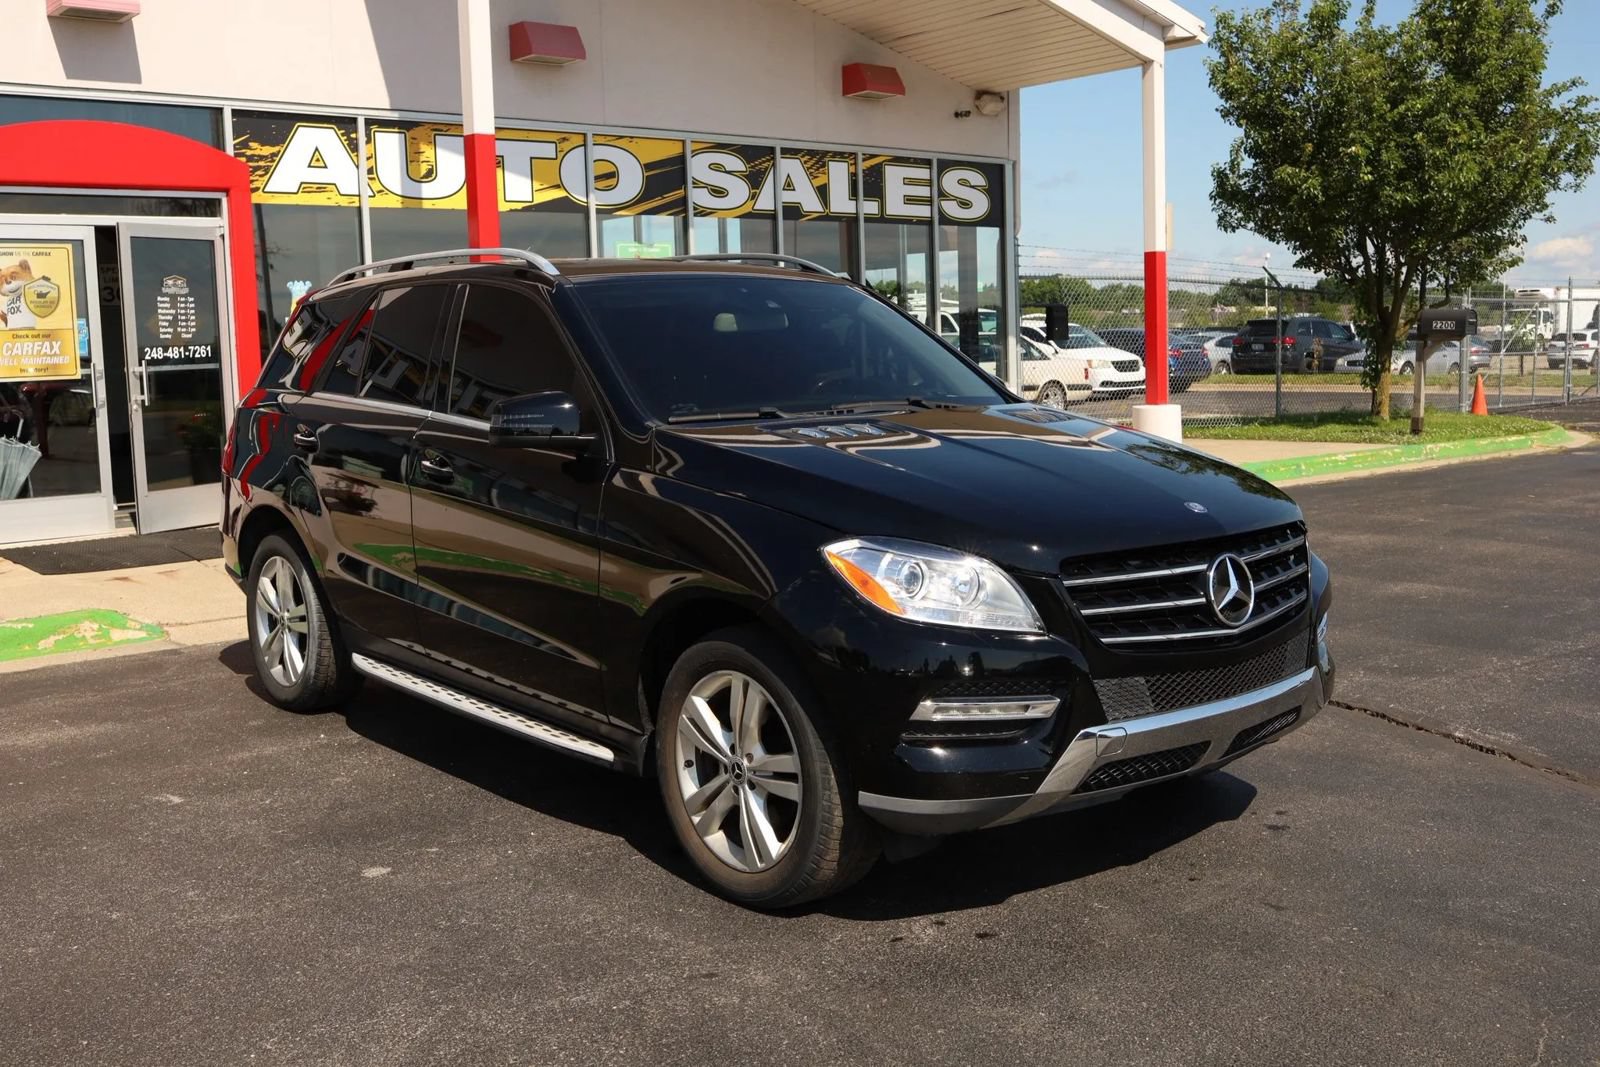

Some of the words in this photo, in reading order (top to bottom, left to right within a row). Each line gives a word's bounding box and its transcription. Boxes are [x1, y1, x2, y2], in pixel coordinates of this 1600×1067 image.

[262, 123, 645, 209] AUTO
[690, 150, 991, 222] SALES
[7, 296, 22, 307] CAR
[7, 305, 22, 315] FOX
[1432, 321, 1455, 329] 2200
[2, 341, 62, 356] CARFAX
[144, 345, 212, 360] 248-481-7261
[22, 356, 70, 365] MAINTAINED
